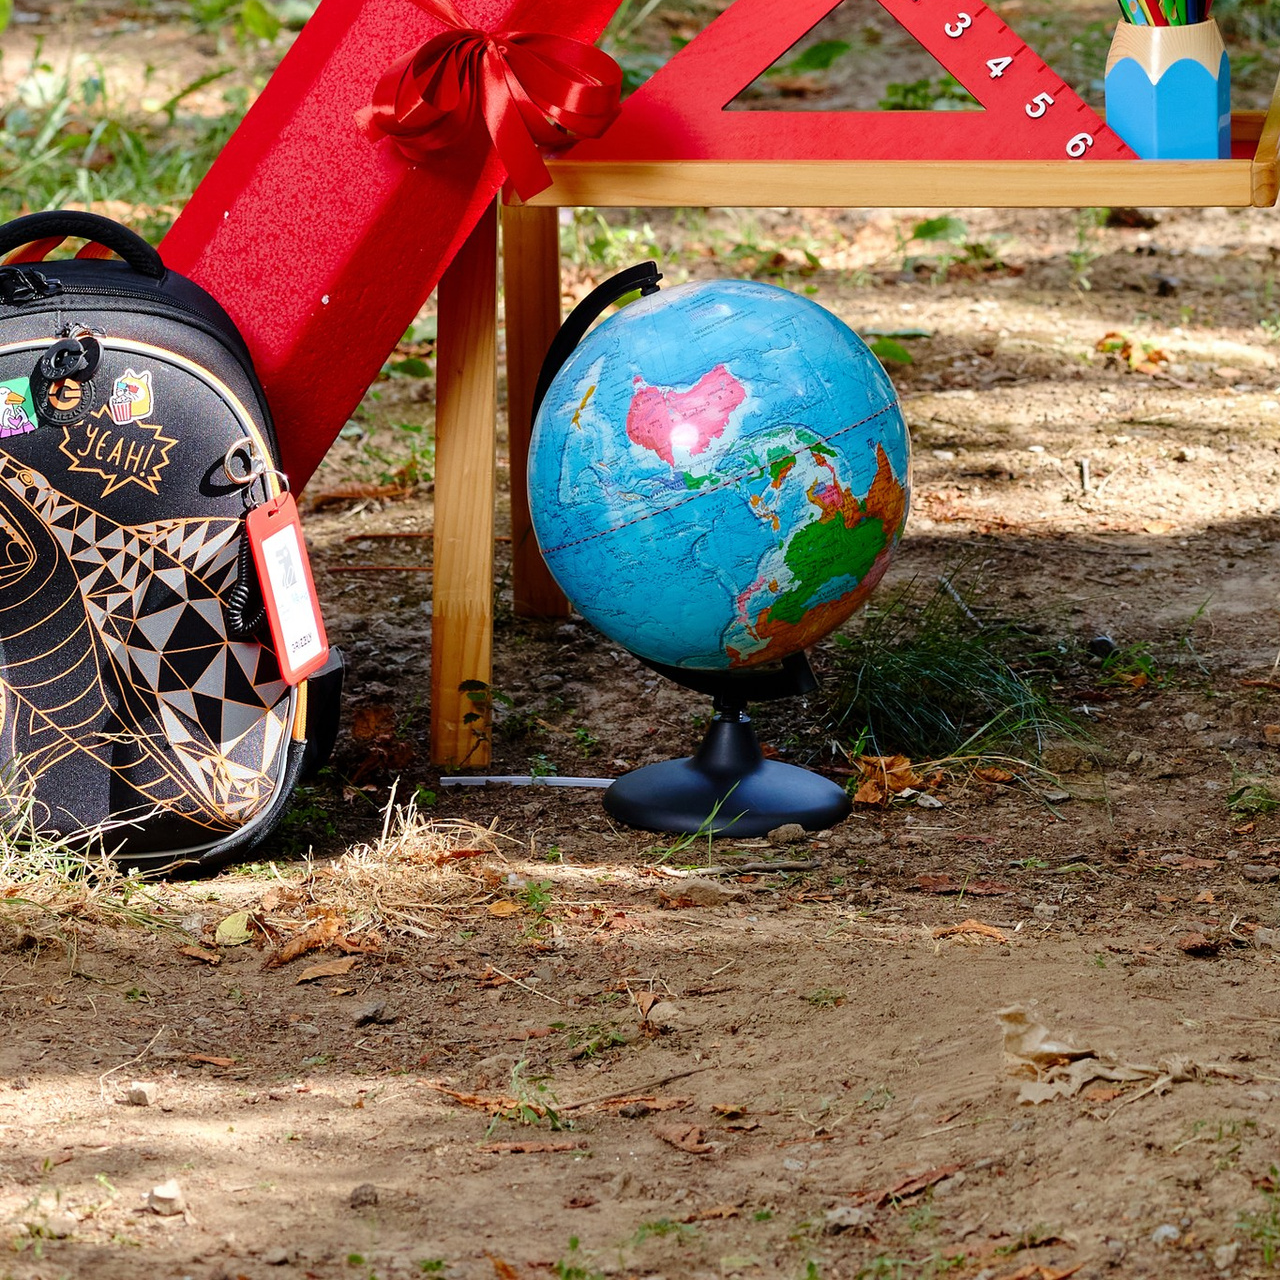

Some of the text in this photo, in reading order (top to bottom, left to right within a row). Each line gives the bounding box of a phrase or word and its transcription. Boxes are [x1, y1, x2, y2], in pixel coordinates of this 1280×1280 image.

[944, 12, 972, 38] 3
[985, 55, 1013, 79] 4
[1025, 91, 1054, 118] 5
[1065, 132, 1093, 158] 6
[77, 423, 156, 477] YEAH!
